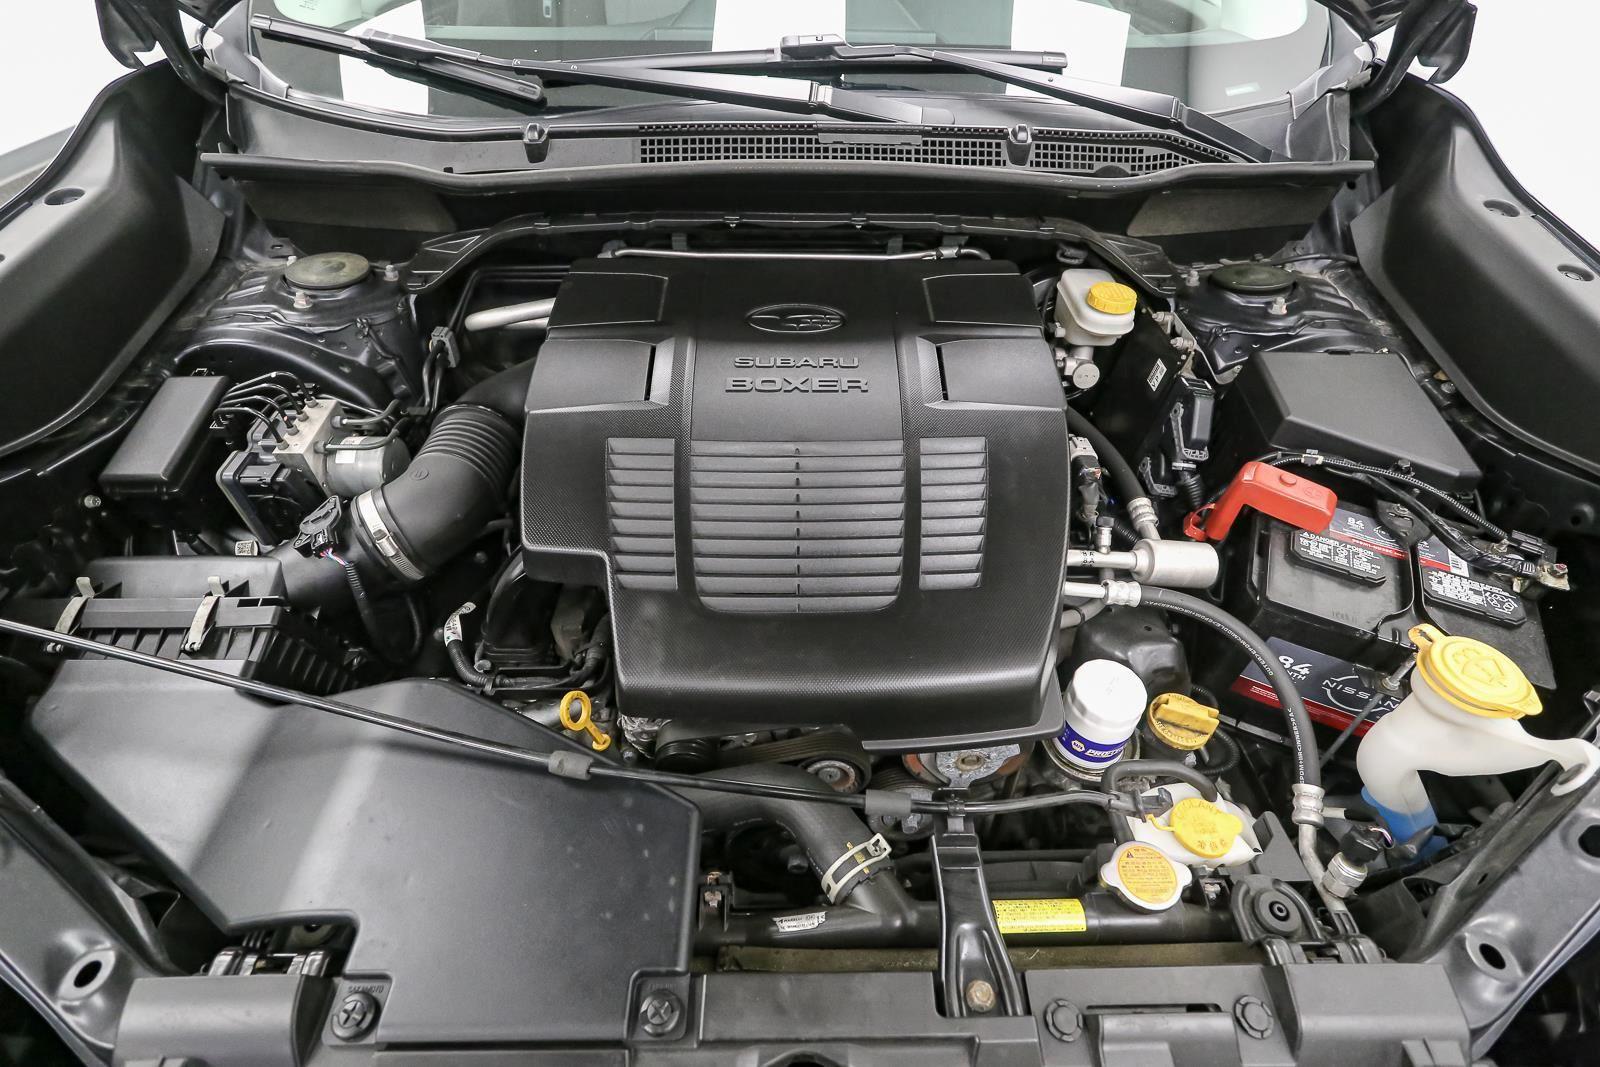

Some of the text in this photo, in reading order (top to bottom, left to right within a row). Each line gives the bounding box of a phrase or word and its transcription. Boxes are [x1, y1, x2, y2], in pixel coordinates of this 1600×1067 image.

[734, 356, 860, 369] SUBARU
[725, 377, 869, 393] BOXER
[1278, 655, 1313, 675] 84
[1322, 679, 1401, 709] NISSN
